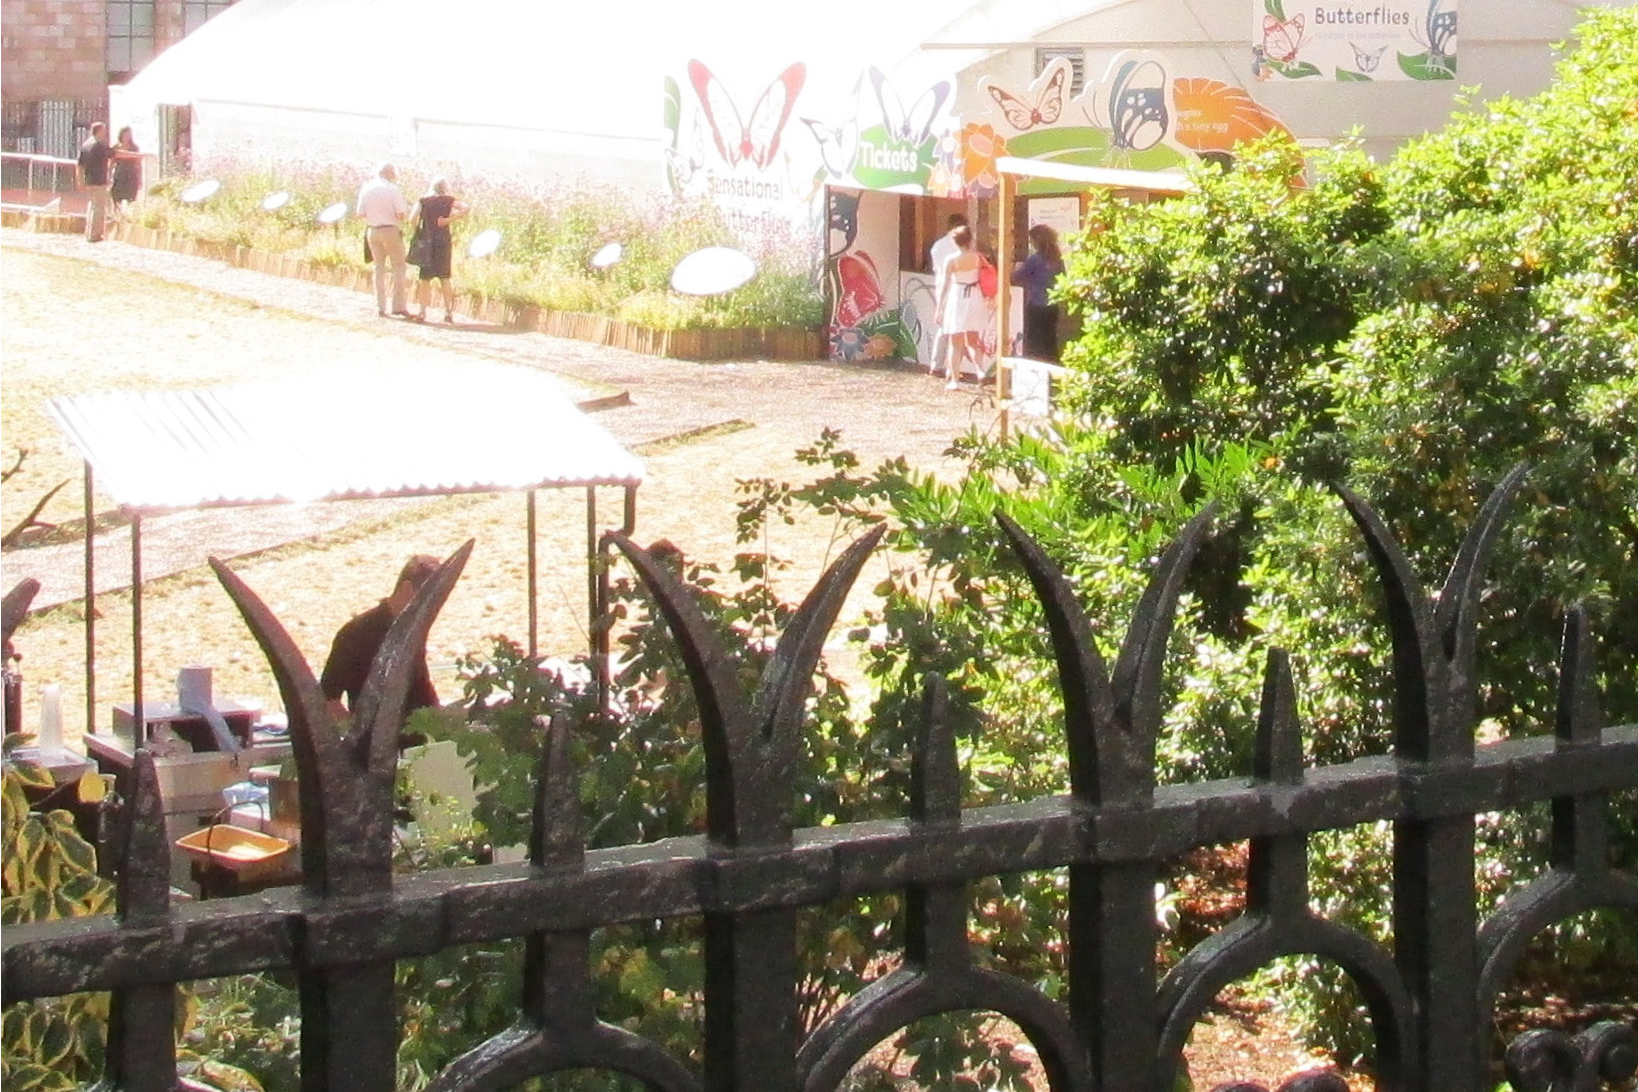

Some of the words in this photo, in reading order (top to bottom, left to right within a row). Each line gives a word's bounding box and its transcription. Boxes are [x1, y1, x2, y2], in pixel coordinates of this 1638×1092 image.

[1314, 4, 1410, 25] Butterflies
[859, 140, 918, 173] Tickets
[707, 168, 784, 202] Sensational
